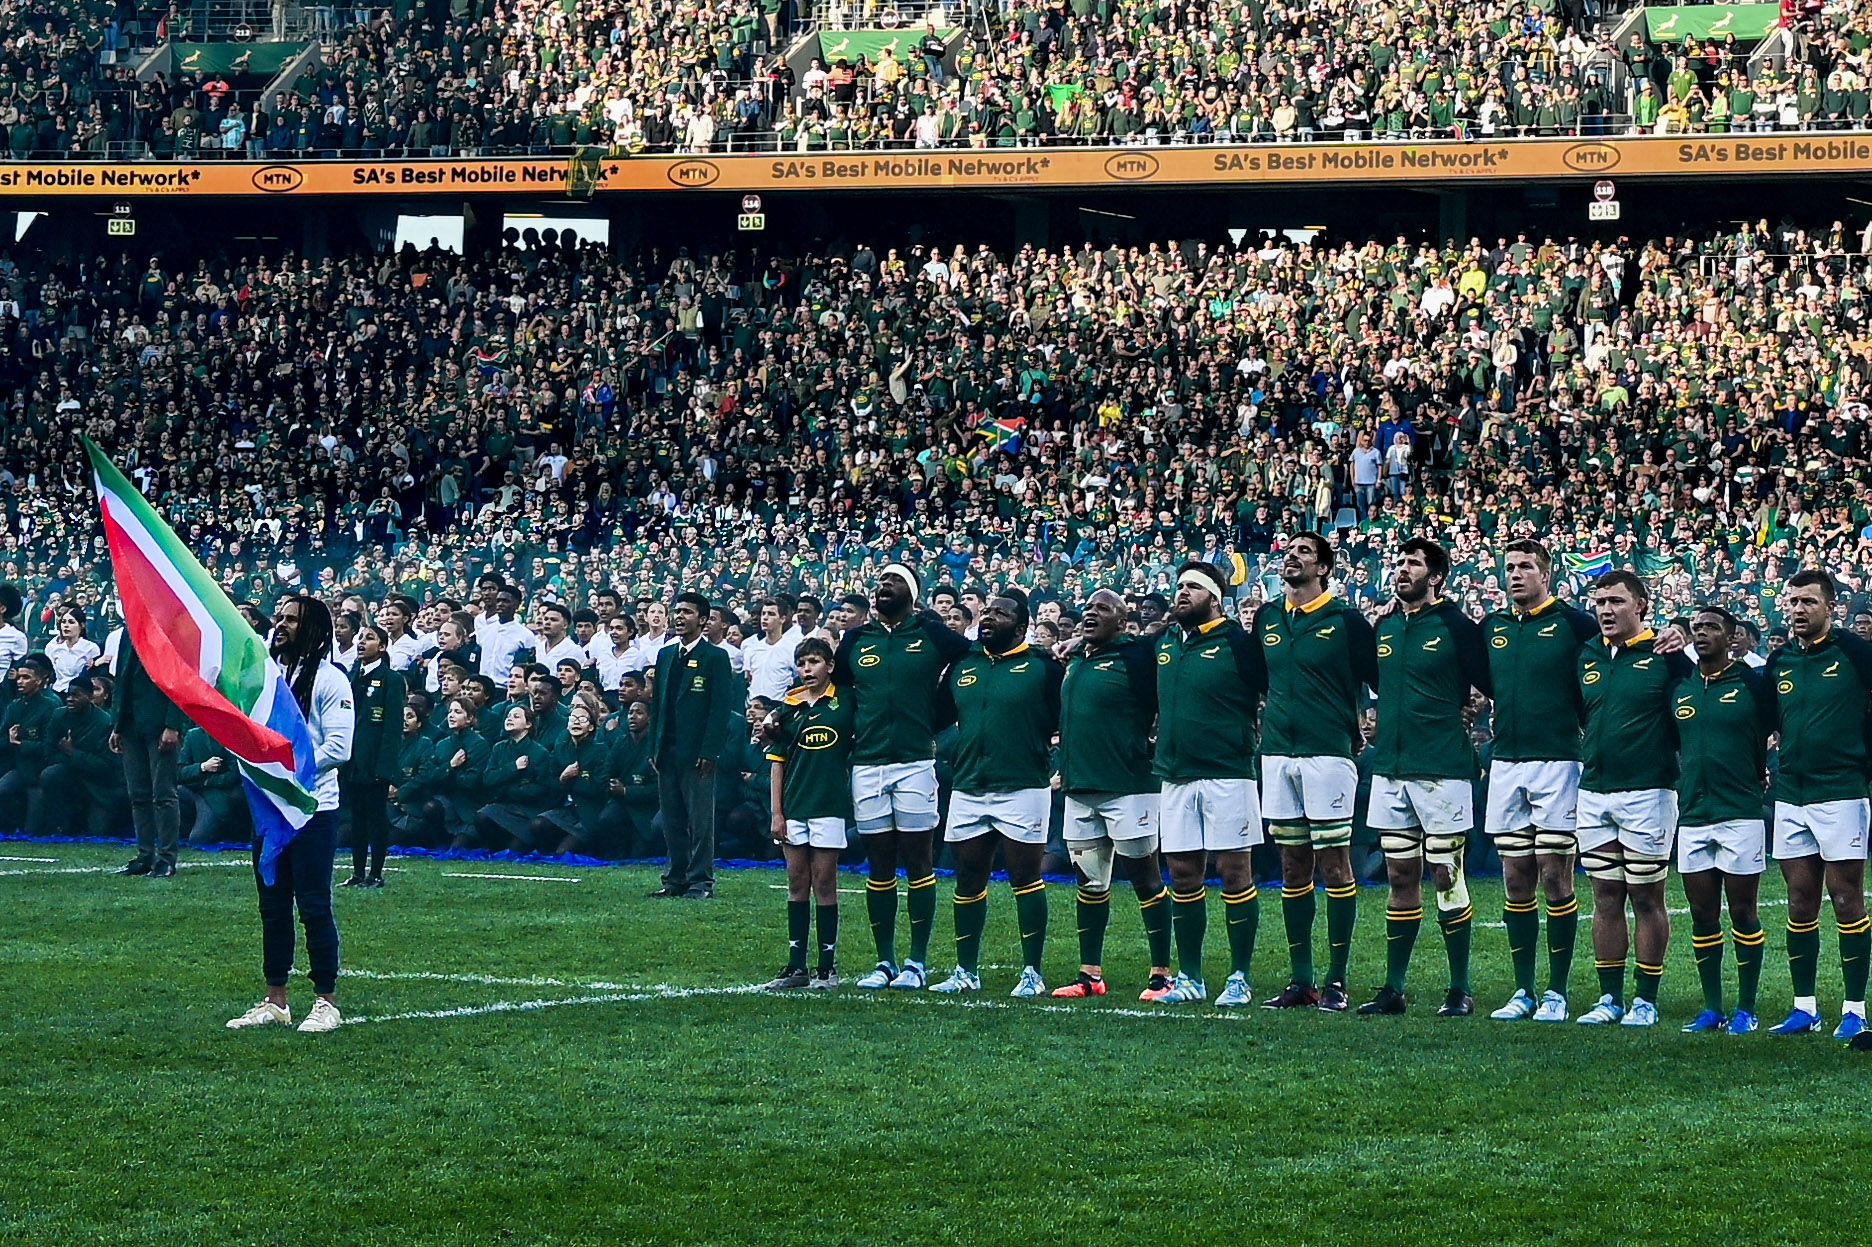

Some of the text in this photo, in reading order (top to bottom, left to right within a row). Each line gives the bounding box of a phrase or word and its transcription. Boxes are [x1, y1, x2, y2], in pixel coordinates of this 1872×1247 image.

[1576, 151, 1608, 164] MTN
[1678, 143, 1729, 163] SA's
[1735, 143, 1787, 162] Best
[1793, 140, 1870, 161] Mobile
[1116, 160, 1147, 172] MTN
[1214, 153, 1261, 171] SA's
[1267, 152, 1317, 170] Best
[1322, 150, 1394, 169] Mobile
[679, 167, 708, 180] MTN
[771, 161, 817, 179] SA's
[822, 160, 869, 178] Best
[873, 158, 942, 177] Mobile
[26, 169, 96, 186] Mobile
[263, 174, 292, 184] MTN
[352, 167, 395, 185] SA's
[401, 167, 445, 184] Best
[451, 166, 516, 183] Mobile
[115, 205, 131, 214] 113
[744, 199, 759, 209] 114
[805, 732, 828, 744] MTN
